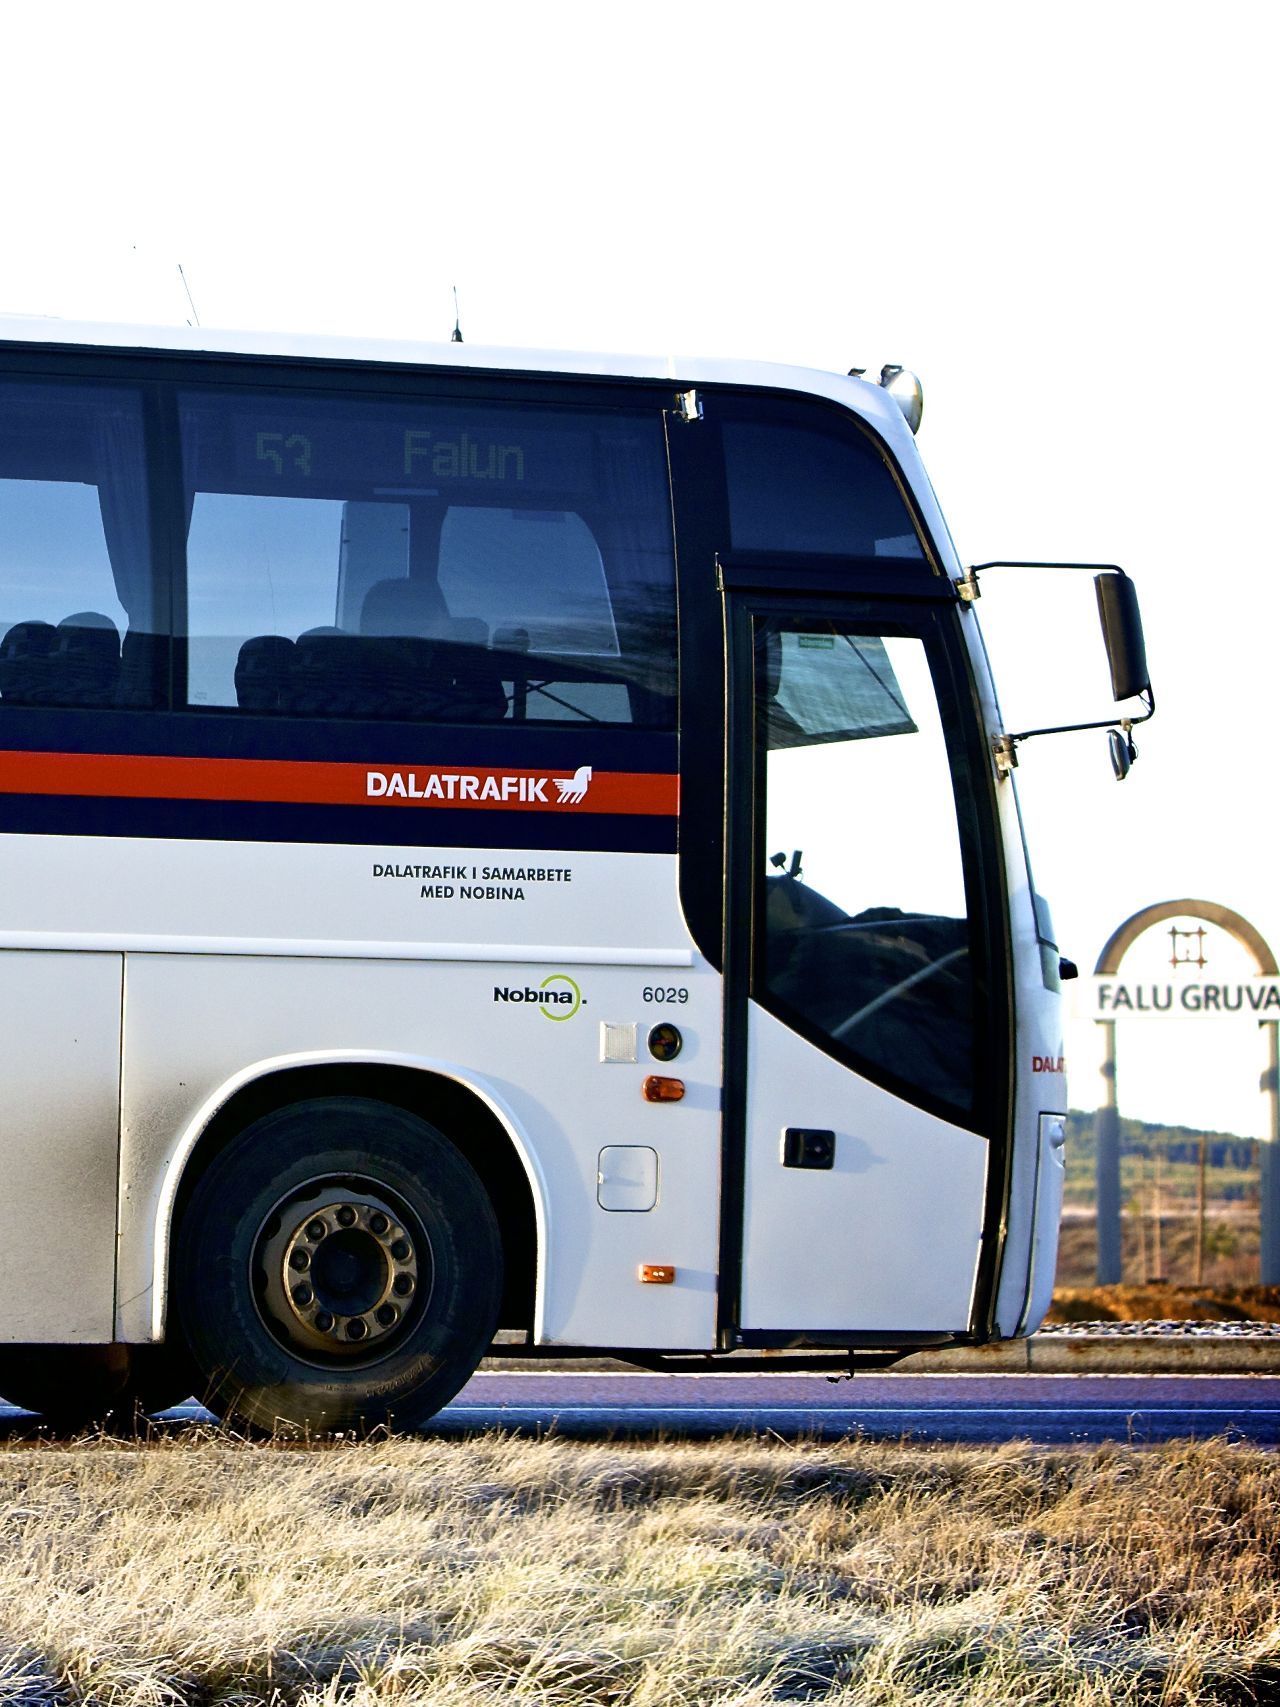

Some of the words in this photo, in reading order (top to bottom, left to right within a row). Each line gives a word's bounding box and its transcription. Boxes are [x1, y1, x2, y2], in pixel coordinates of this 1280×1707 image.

[404, 430, 524, 480] Falun
[366, 771, 548, 803] DALATRAFIK
[372, 864, 466, 880] DALATRAFIK
[482, 866, 572, 882] SAMARBETE
[420, 885, 454, 899] MED
[459, 887, 525, 901] NOBINA
[642, 987, 689, 1005] 6029
[1098, 984, 1171, 1011] FALU
[1180, 984, 1280, 1011] GRUVA
